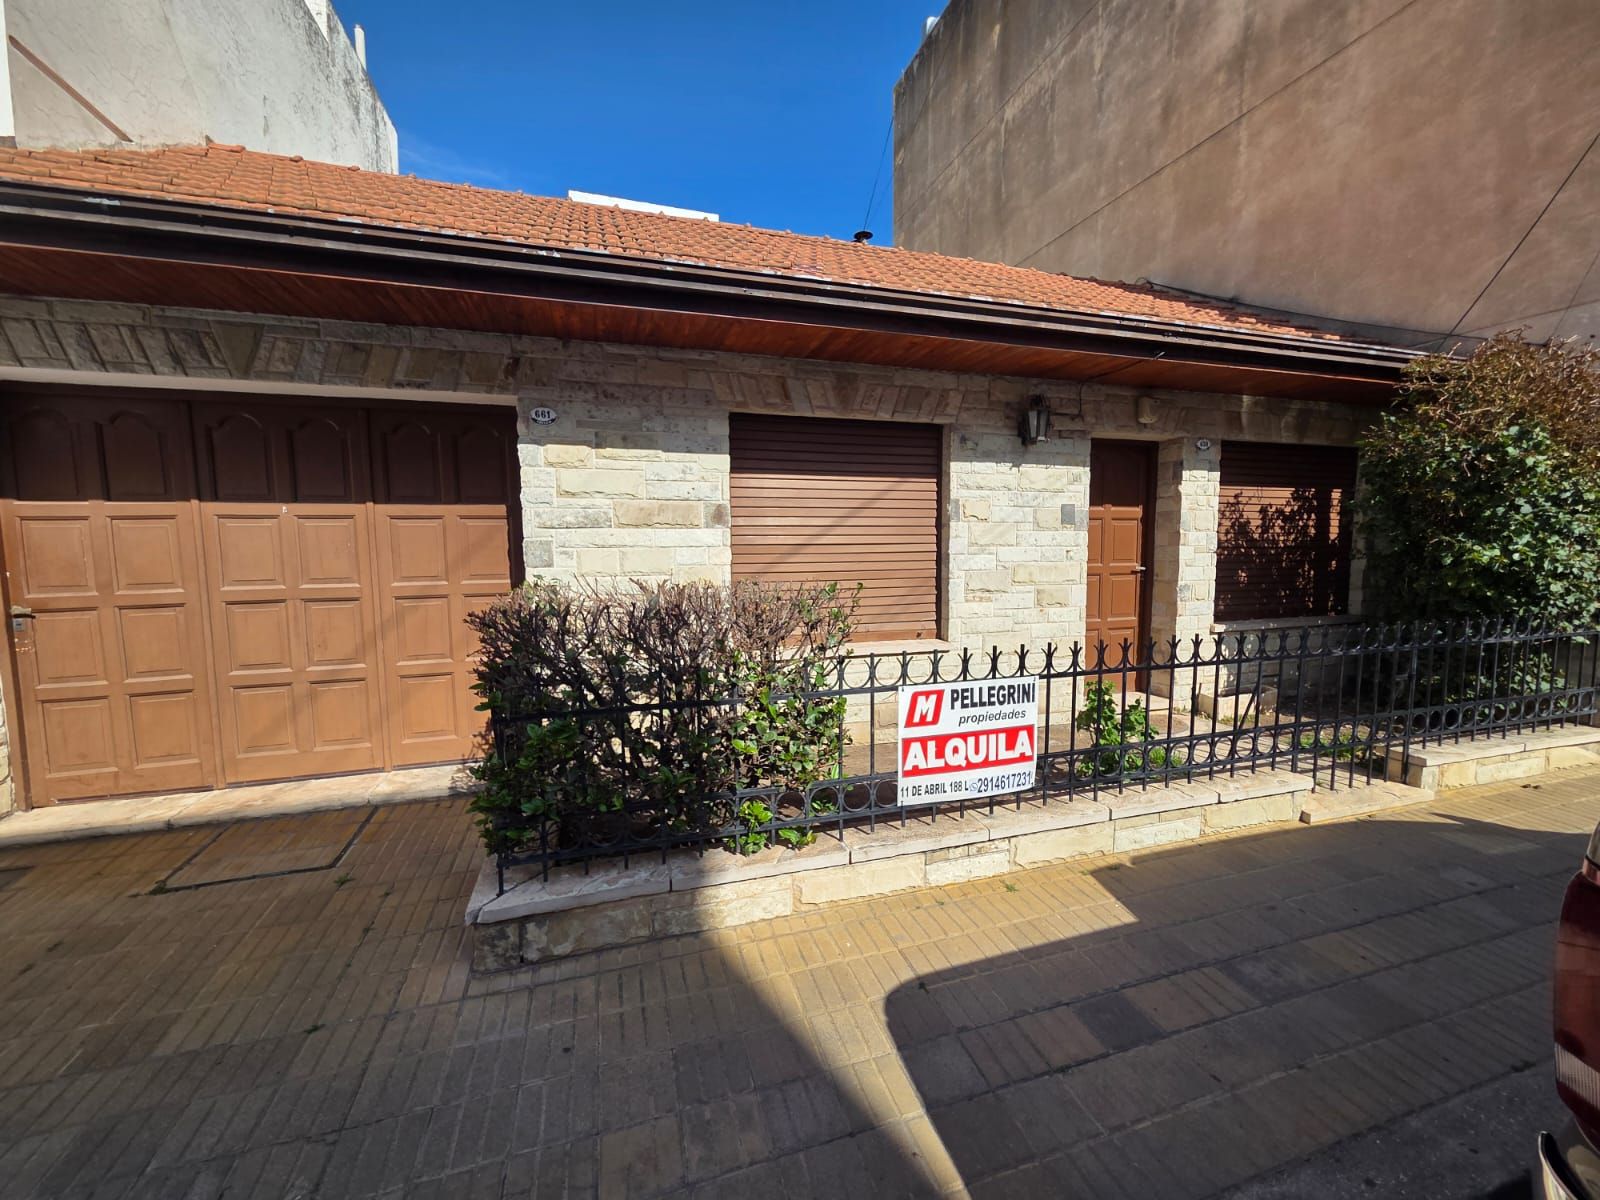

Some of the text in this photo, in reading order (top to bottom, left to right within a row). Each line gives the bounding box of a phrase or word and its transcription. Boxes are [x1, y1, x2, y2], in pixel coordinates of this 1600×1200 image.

[534, 409, 551, 419] 661
[912, 693, 938, 723] M
[950, 682, 1036, 710] PELLEGRINI
[958, 708, 1026, 727] propiedades
[903, 729, 1033, 771] ALQUILA
[900, 785, 909, 798] 11
[911, 785, 922, 797] DE
[924, 782, 948, 795] ABRIL
[949, 780, 963, 793] 188
[977, 770, 1032, 793] 2914617231
